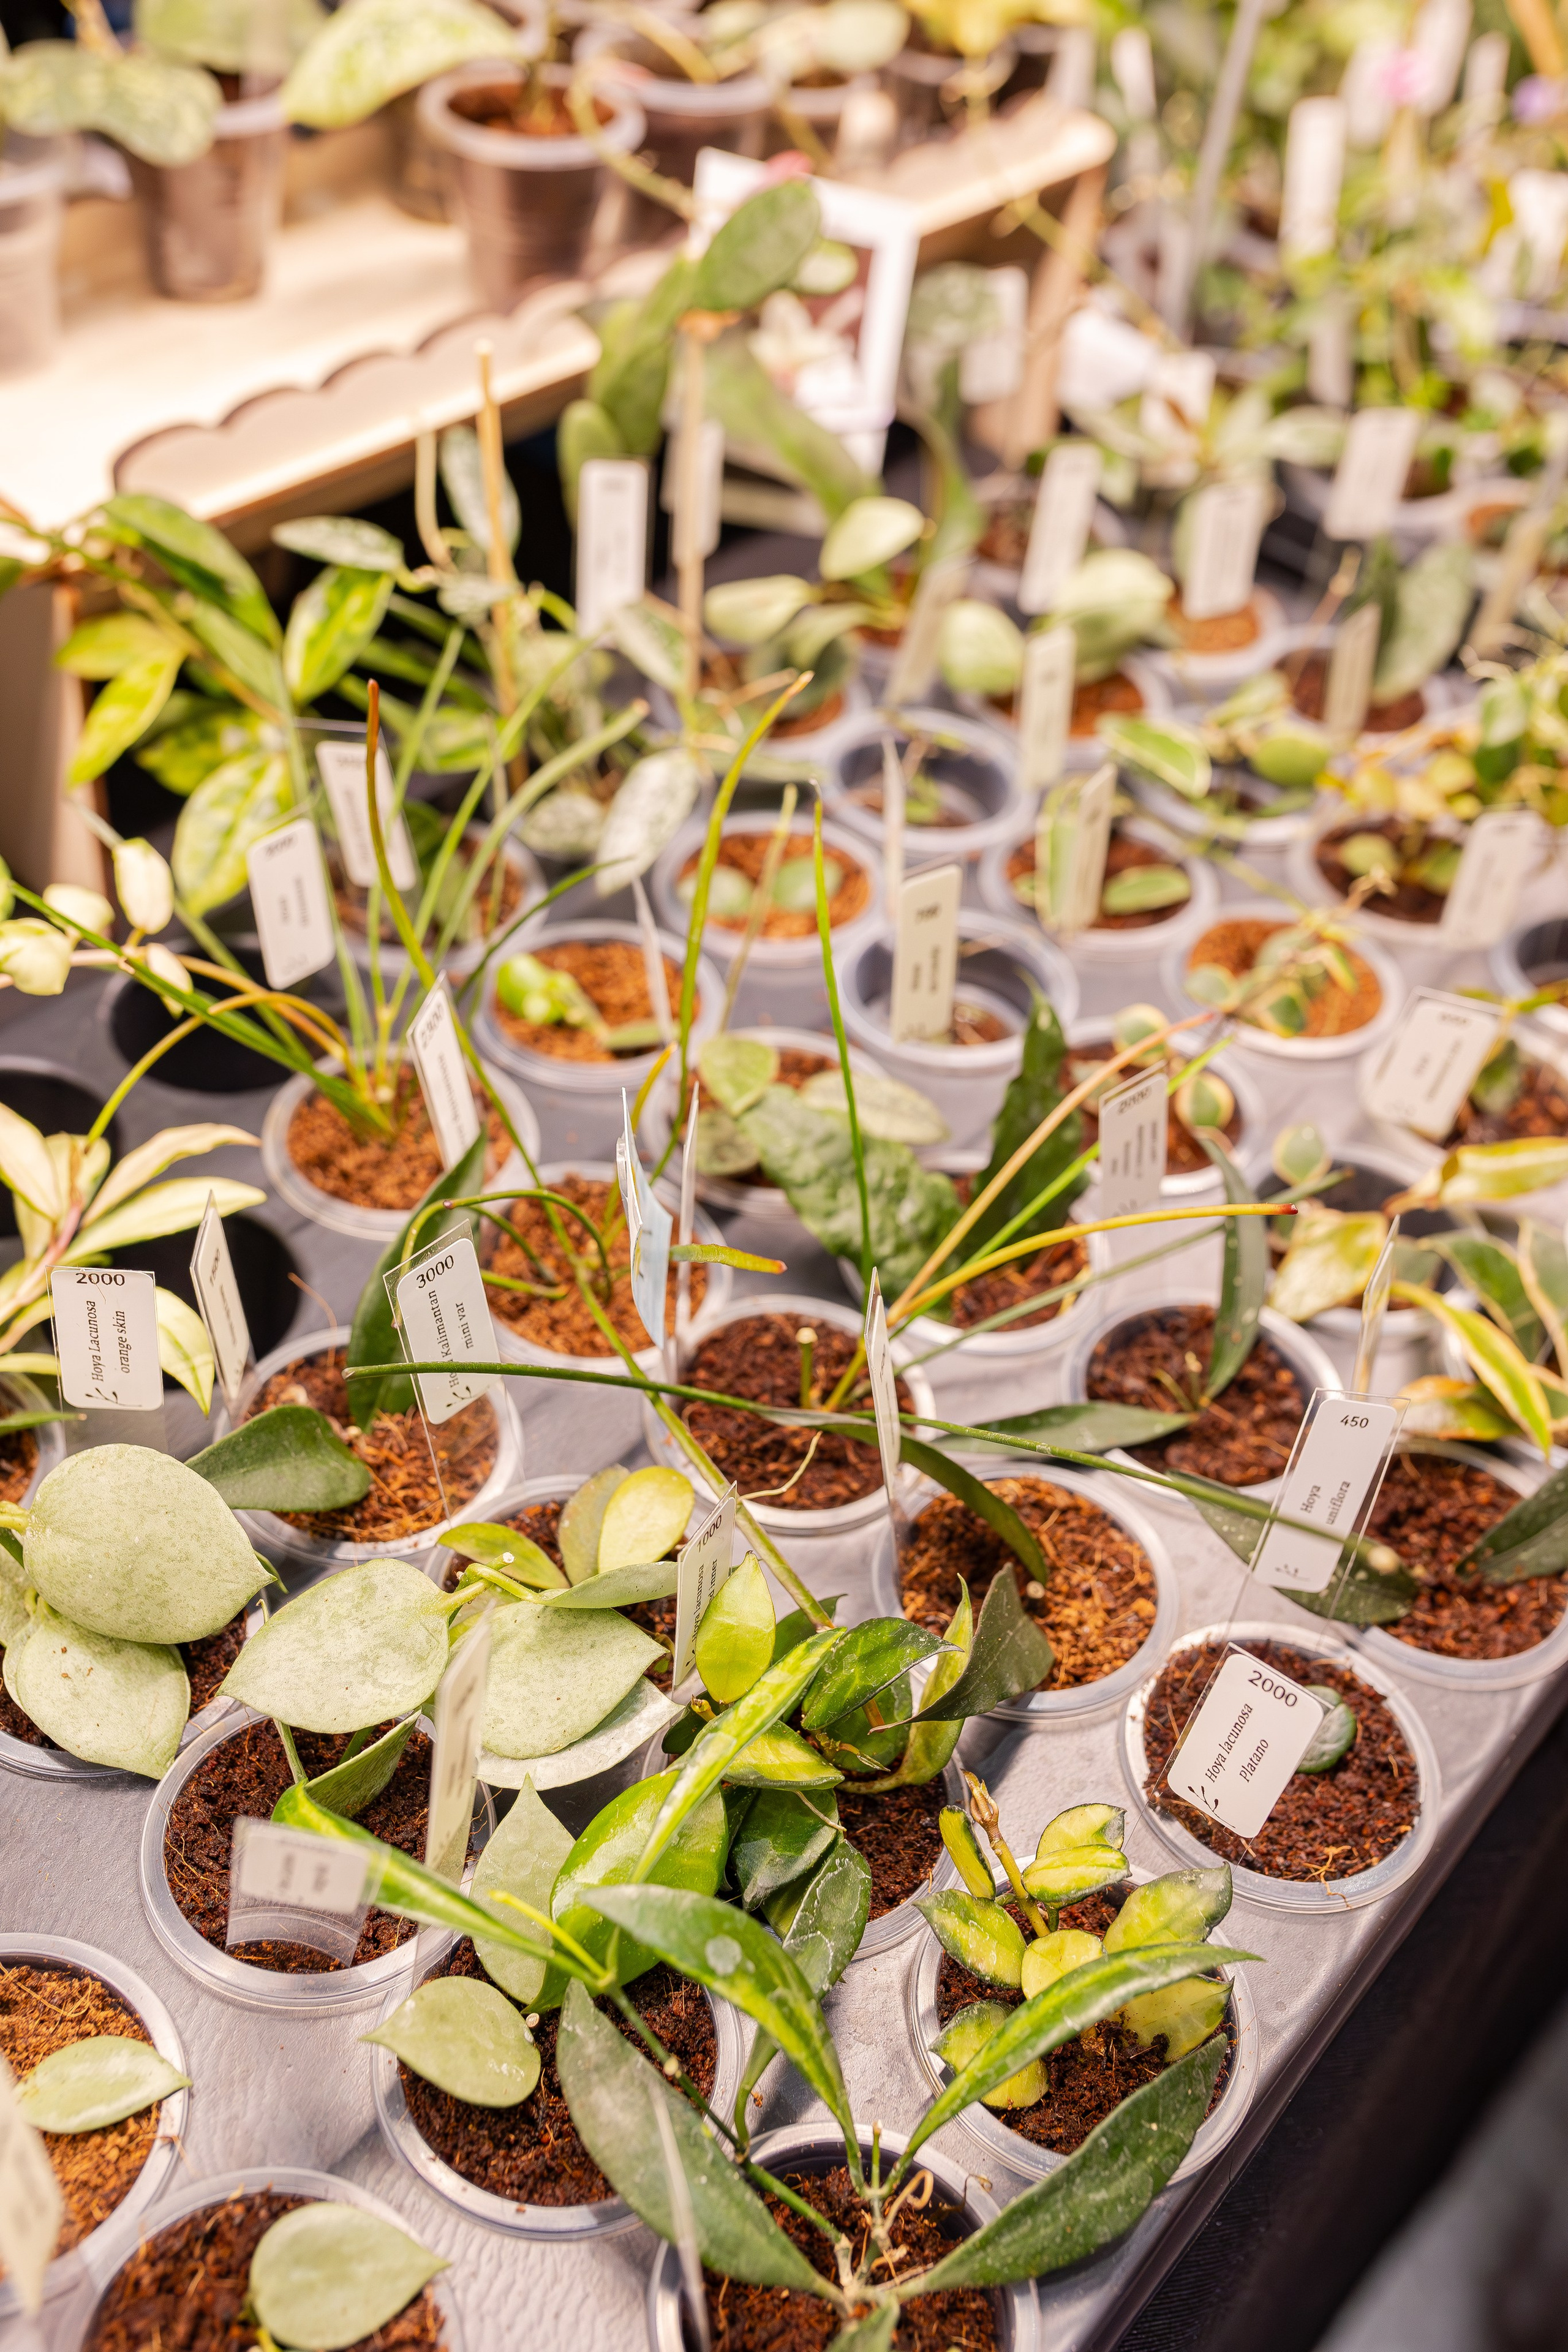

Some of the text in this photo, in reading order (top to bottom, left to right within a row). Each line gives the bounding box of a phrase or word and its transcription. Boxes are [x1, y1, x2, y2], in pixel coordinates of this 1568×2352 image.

[75, 1272, 126, 1286] 2000
[416, 1254, 454, 1289] 3000
[86, 1300, 106, 1382] Hoya Lacunosa
[112, 1310, 132, 1374] orange skin
[428, 1289, 459, 1388] Ho Kalimantan
[455, 1302, 474, 1349] mini var
[1340, 1414, 1370, 1428] 450
[1300, 1485, 1322, 1514] Hoya
[1325, 1480, 1351, 1525] uniflora
[696, 1514, 722, 1553] 1000
[709, 1558, 718, 1591] inner
[692, 1563, 705, 1643] Hoya lacunosa
[1248, 1669, 1298, 1708] 2000
[1205, 1703, 1254, 1783] Hoya lacunosa
[1238, 1738, 1269, 1784] Platano
